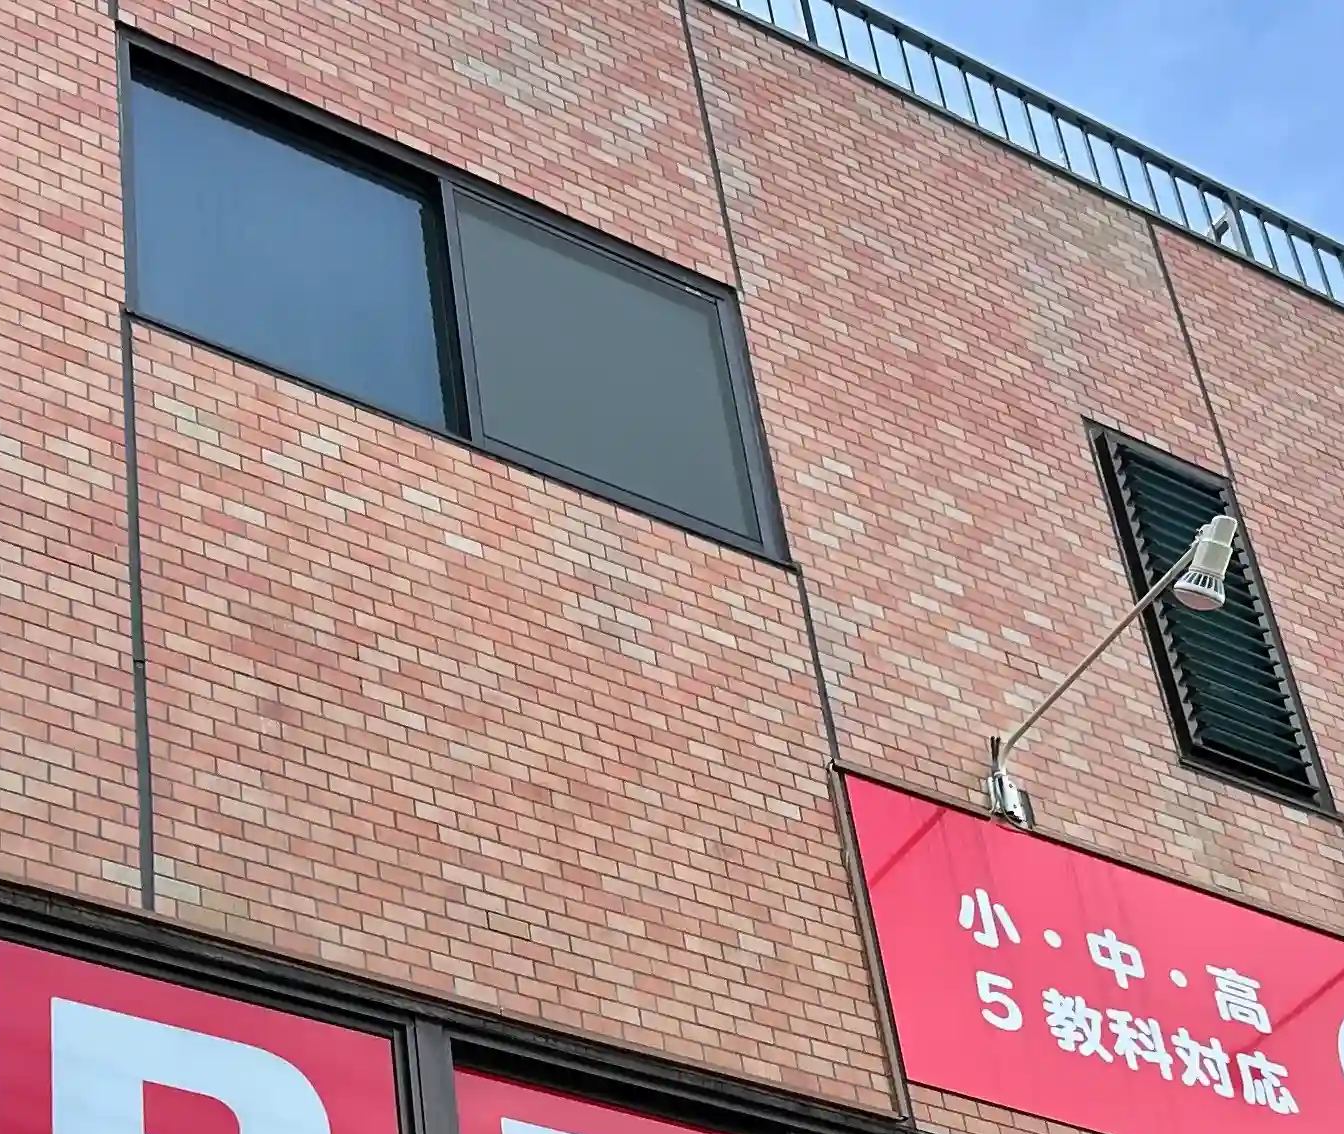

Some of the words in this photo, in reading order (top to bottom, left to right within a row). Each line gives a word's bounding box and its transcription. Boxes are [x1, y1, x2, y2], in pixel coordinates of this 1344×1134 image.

[959, 888, 1273, 1034] 小・中・高
[976, 970, 1300, 1116] 5教科対応
